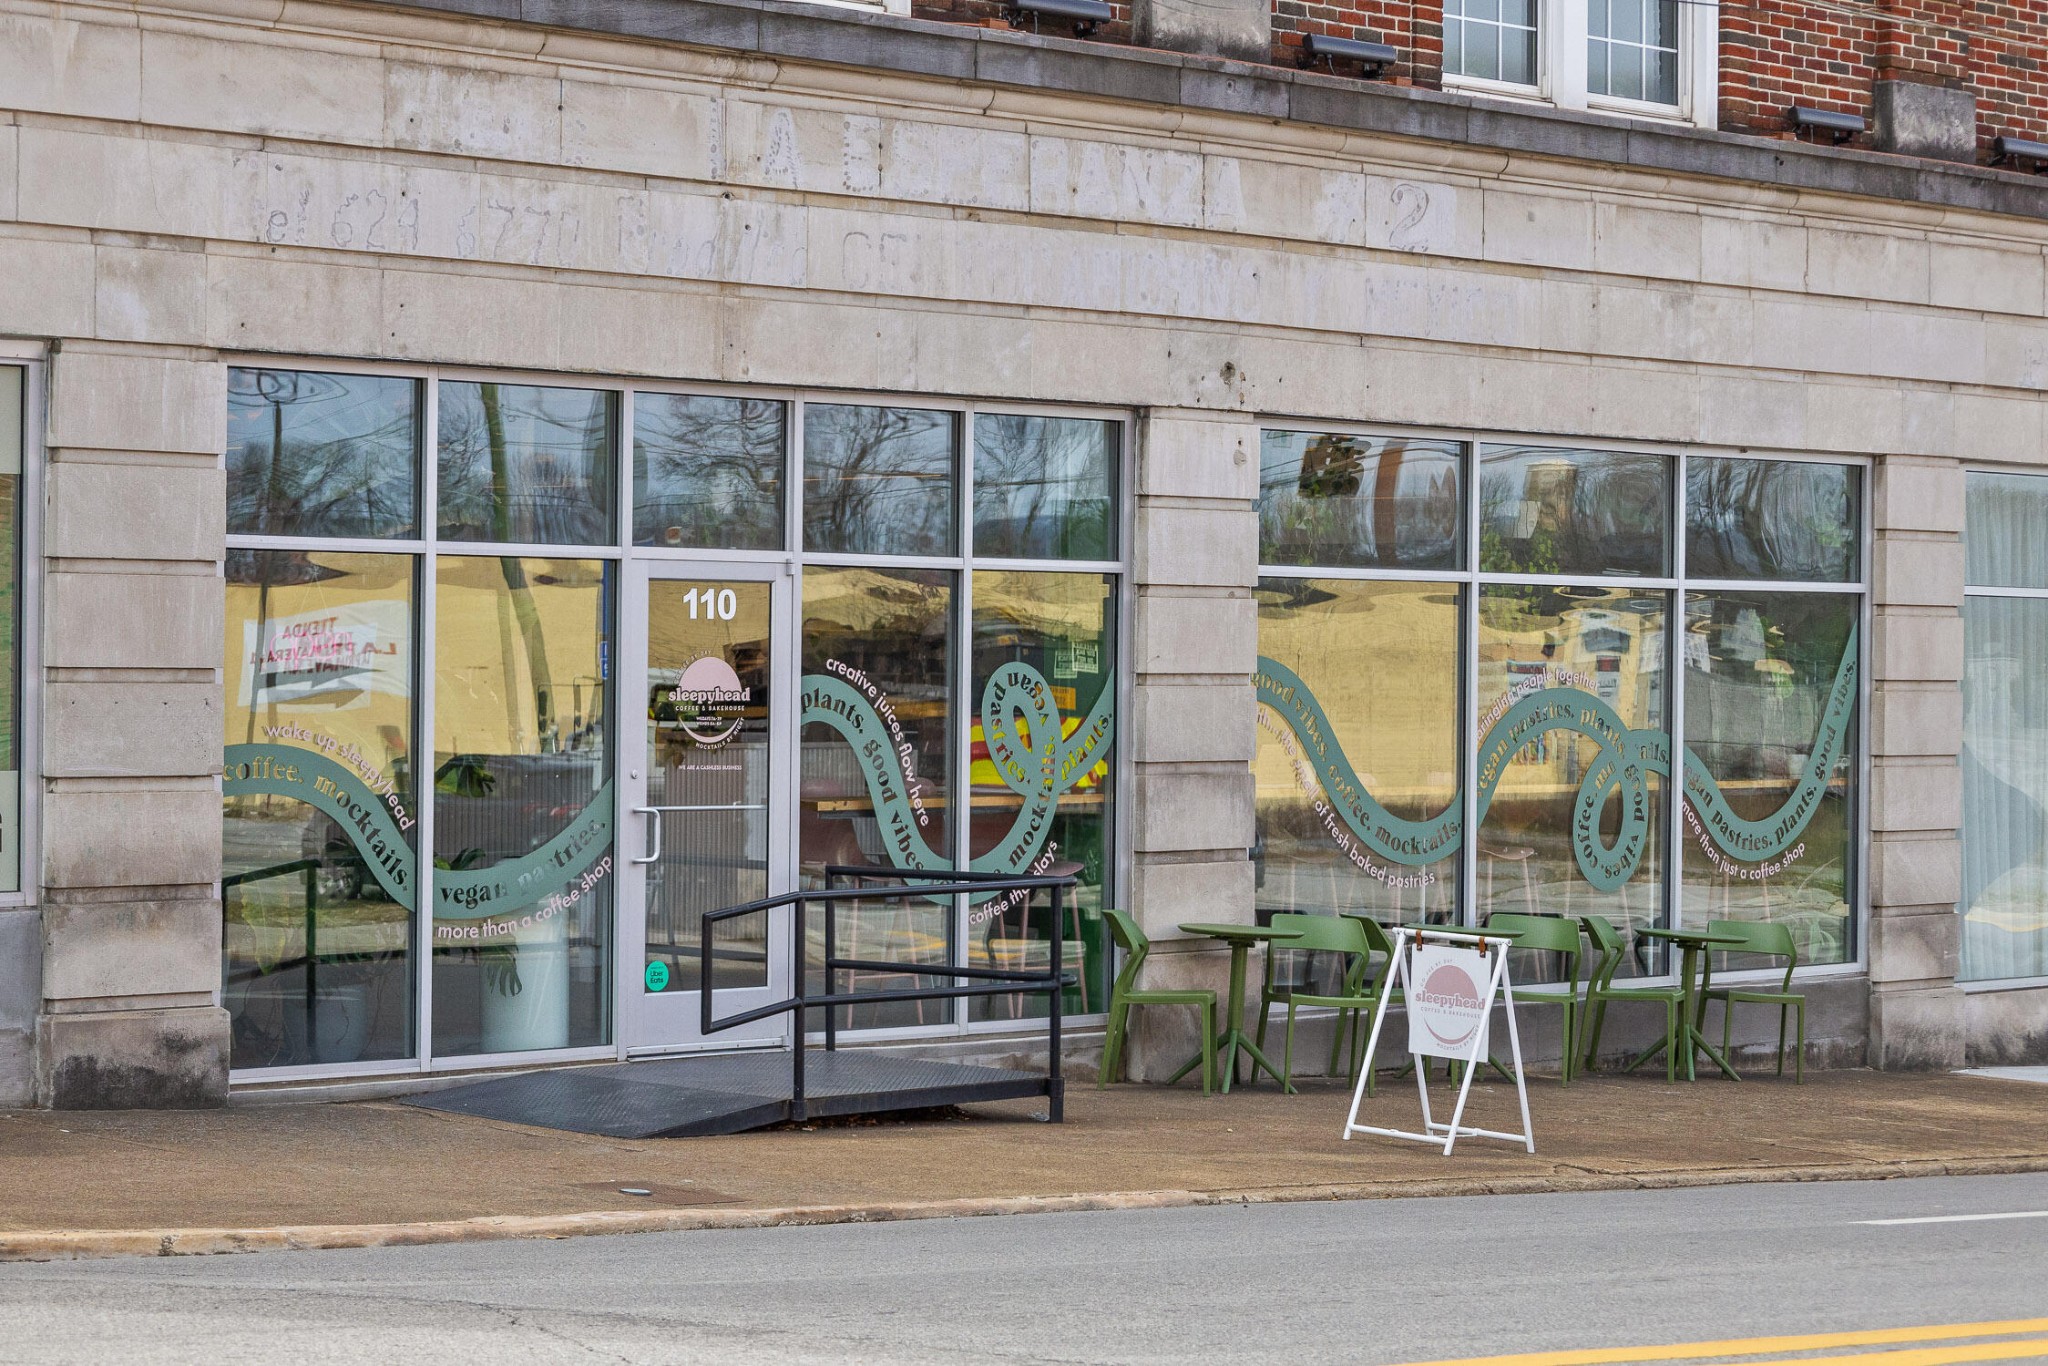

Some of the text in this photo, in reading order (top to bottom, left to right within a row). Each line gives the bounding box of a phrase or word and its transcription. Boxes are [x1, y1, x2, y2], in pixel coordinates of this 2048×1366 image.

[683, 587, 737, 621] 110
[668, 686, 751, 704] sleepyhead
[1006, 671, 1049, 728] vegan
[695, 741, 726, 750] MOCKTAILS
[801, 687, 864, 735] plants.
[862, 738, 898, 804] good
[825, 657, 930, 828] creative juices flow here
[990, 680, 1031, 785] pastries.
[1061, 713, 1113, 781] plants.
[1478, 739, 1509, 799] egan
[1710, 809, 1773, 851] pastries.
[1774, 786, 1818, 846] plants.
[1814, 723, 1837, 782] good
[1832, 660, 1857, 718] vibes.
[265, 720, 416, 831] wake up sleepyhead
[1008, 735, 1056, 869] mocktails.
[312, 774, 408, 893] mocktails.
[1314, 799, 1329, 818] of
[1324, 812, 1350, 853] fresh
[1349, 843, 1388, 882] baked
[1387, 871, 1436, 890] pastries
[1375, 819, 1462, 856] mocktails.
[1682, 800, 1806, 880] more than just a coffee shop
[437, 855, 613, 940] more than a coffee shop
[440, 882, 509, 910] vegan
[969, 901, 1009, 925] coffee
[1415, 990, 1486, 1010] sleepyhead
